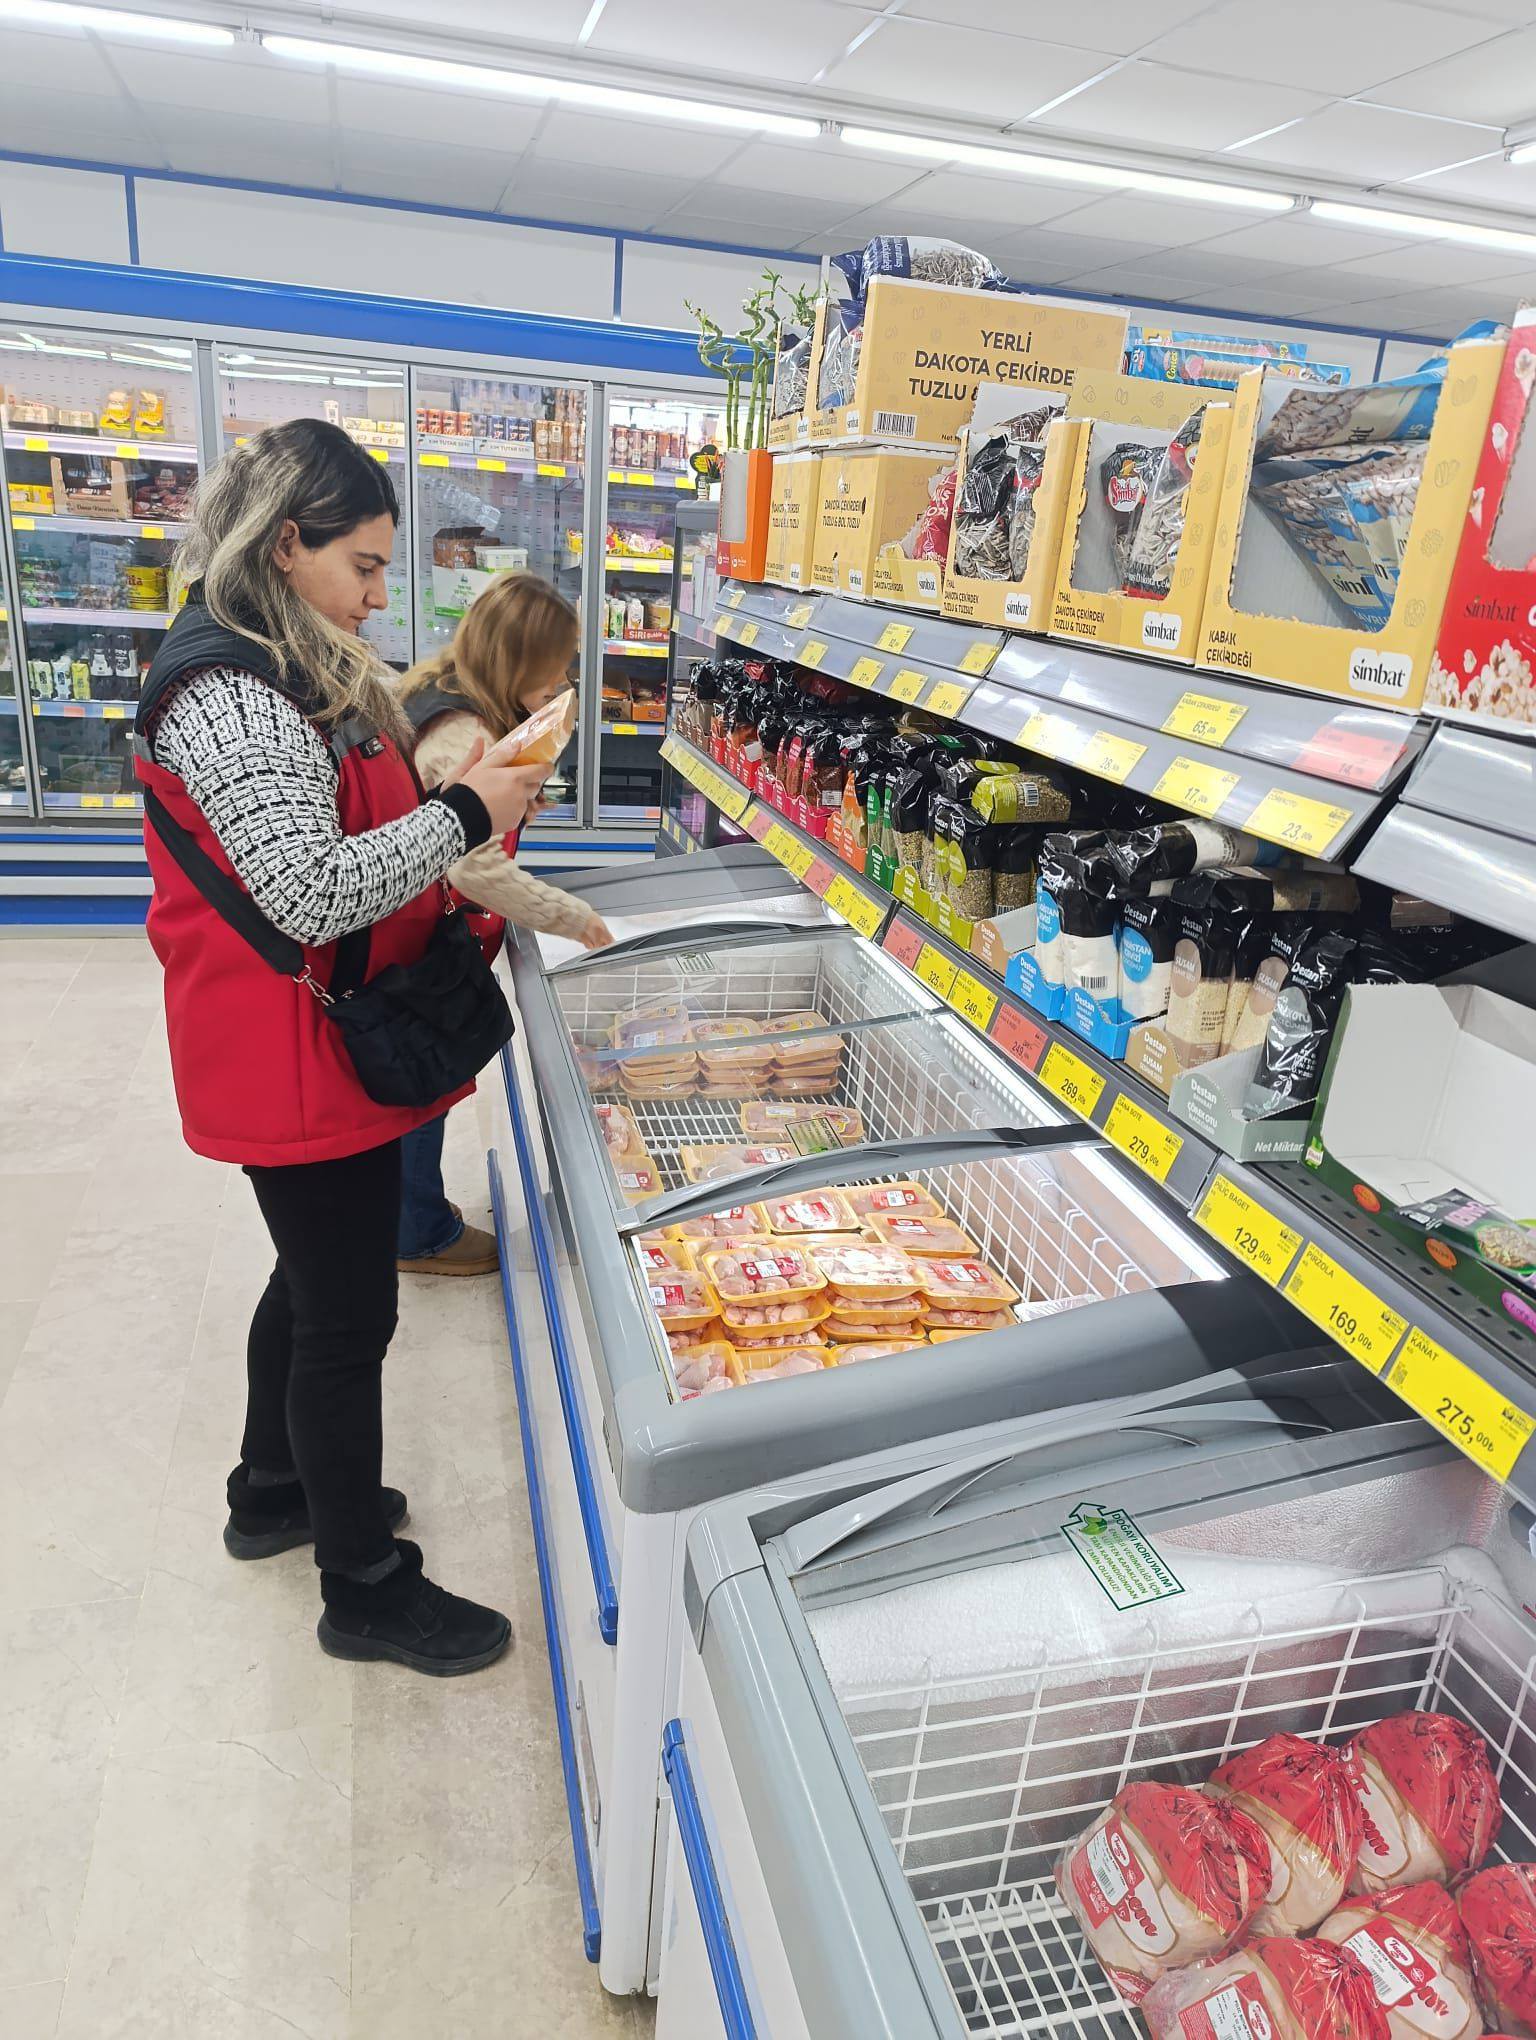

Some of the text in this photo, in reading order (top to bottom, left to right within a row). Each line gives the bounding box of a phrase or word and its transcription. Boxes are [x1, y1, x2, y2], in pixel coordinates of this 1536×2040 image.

[981, 330, 1032, 353] YERLİ
[914, 350, 1076, 386] DAKOTA ÇEKİRDE
[909, 378, 967, 401] TUZLU
[1006, 599, 1029, 617] simbat
[1055, 606, 1105, 624] DAKOTA ÇEKİRDEK
[1464, 594, 1519, 622] simbat
[1053, 619, 1070, 631] TUZLU
[1075, 622, 1097, 636] TUZSUZ
[1144, 617, 1177, 642] simbat
[1209, 629, 1237, 646] KABAK
[1206, 645, 1253, 669] ÇEKİRDEĞİ
[1352, 659, 1406, 688] simbat
[1124, 904, 1148, 924] Destan
[1181, 916, 1203, 934] Destan
[1021, 957, 1036, 974] Destan
[1175, 955, 1195, 972] SUSAM
[1291, 962, 1320, 982] Destan
[1257, 972, 1279, 991] SUSAM
[1075, 992, 1094, 1012] Destan
[1144, 1031, 1167, 1055] Destan
[1143, 1053, 1163, 1073] SUSAM
[1191, 1078, 1217, 1105] Destan
[1128, 1135, 1160, 1168] 279,00₺
[1254, 1142, 1271, 1152] Net
[1228, 1191, 1250, 1212] BAGET
[1233, 1226, 1273, 1266] 129,00₺
[1328, 1303, 1373, 1352] 169,00₺
[1410, 1336, 1439, 1362] KANAT
[1436, 1396, 1495, 1453] 275,00₺
[1112, 1513, 1138, 1542] DOĞAYI
[1134, 1542, 1173, 1589] KORUYALIM
[1117, 1556, 1149, 1594] KAPAKLARIN
